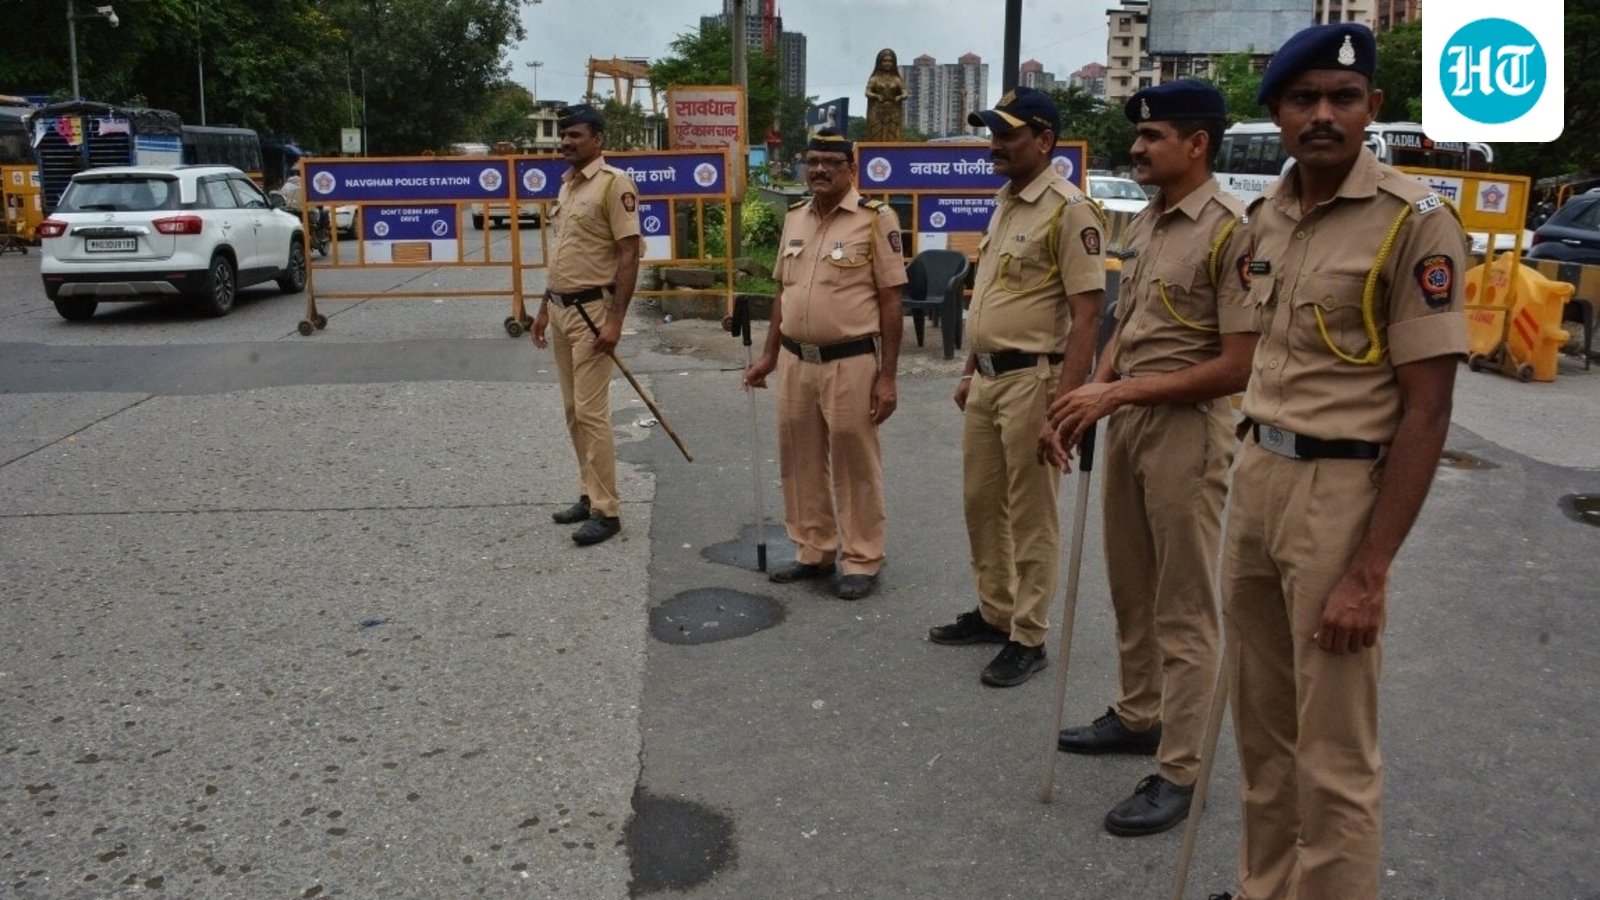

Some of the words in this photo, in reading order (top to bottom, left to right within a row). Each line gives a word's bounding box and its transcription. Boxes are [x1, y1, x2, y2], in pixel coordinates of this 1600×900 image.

[675, 99, 737, 116] सावधान
[1386, 133, 1421, 148] RADHA
[649, 166, 676, 182] ठाणे
[910, 162, 950, 175] नवघर
[345, 179, 393, 188] NAVGHAR
[395, 178, 428, 187] POLICE
[429, 177, 471, 186] STATION
